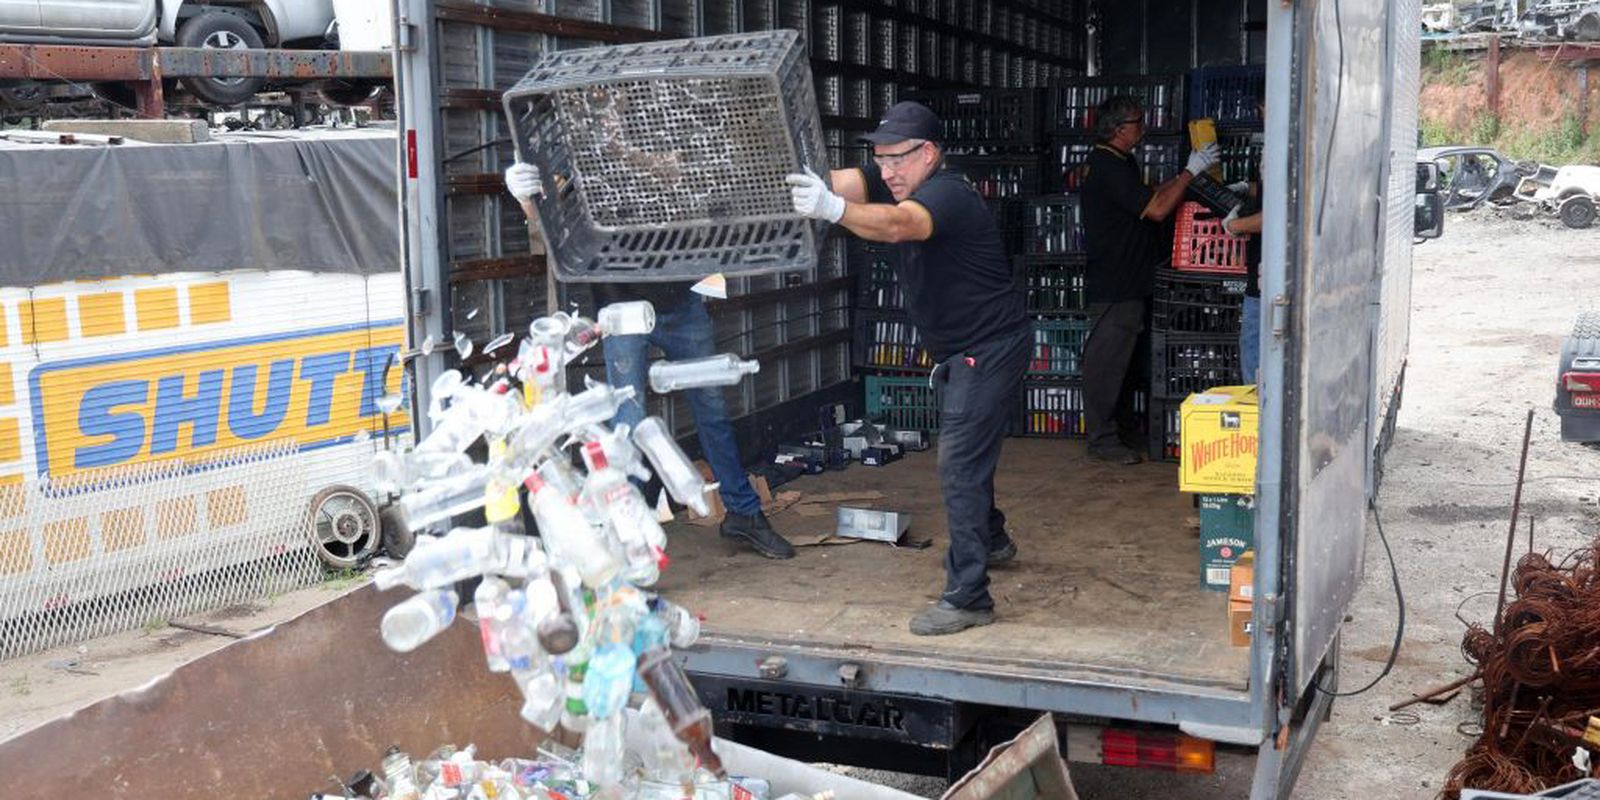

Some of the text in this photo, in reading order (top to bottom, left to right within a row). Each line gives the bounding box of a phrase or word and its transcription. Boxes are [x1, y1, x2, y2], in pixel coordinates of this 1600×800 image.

[1191, 432, 1257, 474] WHITE HOR
[1206, 537, 1247, 548] JAMESON
